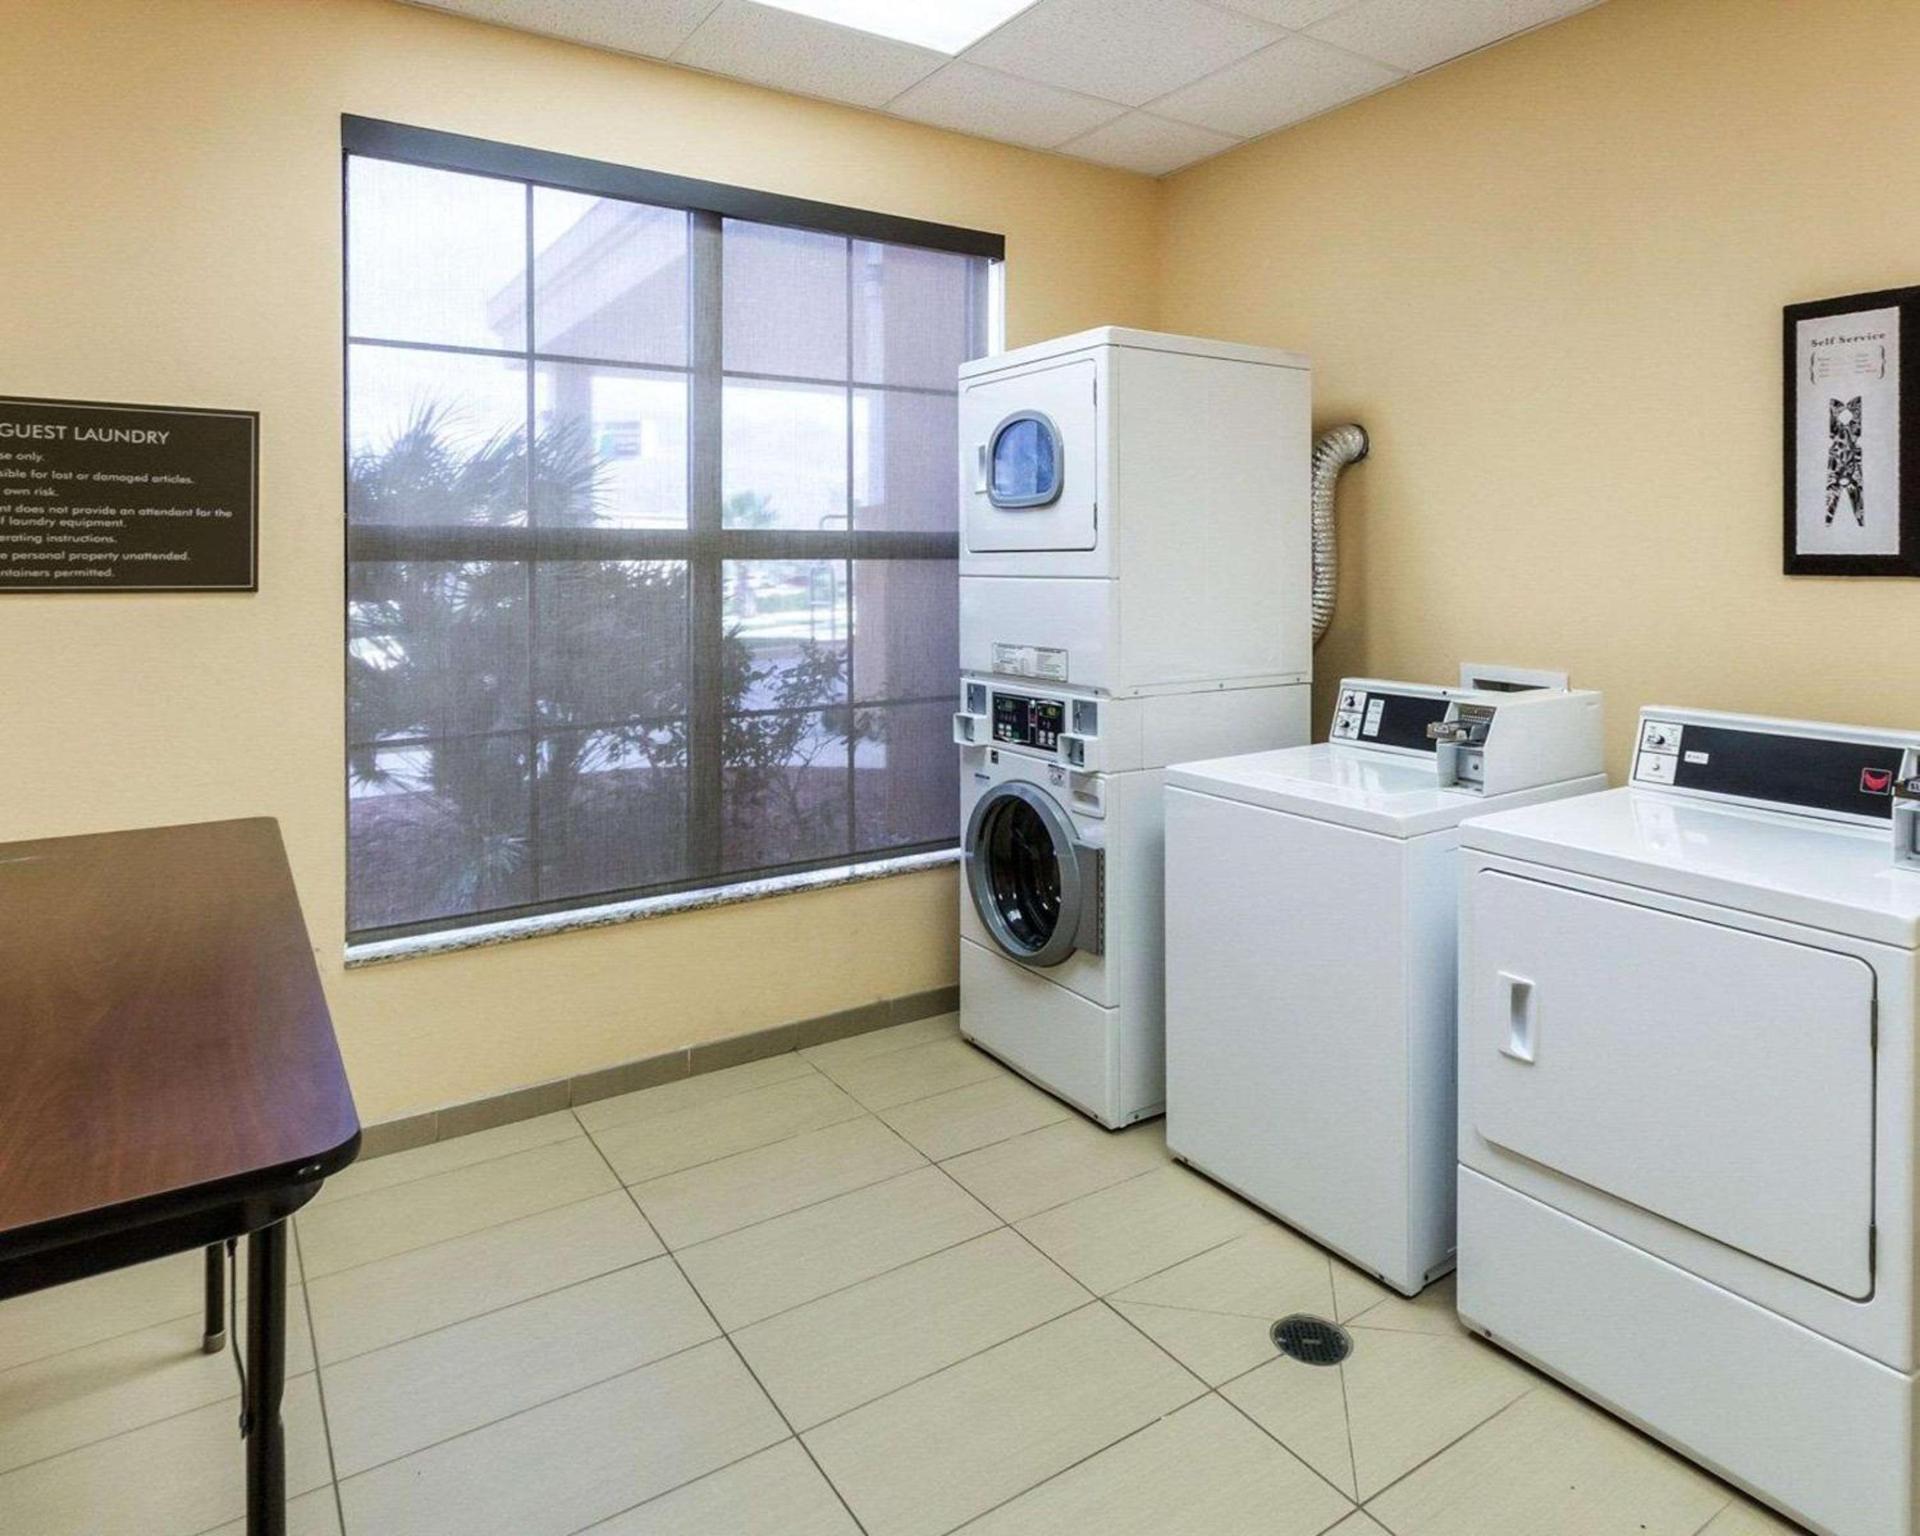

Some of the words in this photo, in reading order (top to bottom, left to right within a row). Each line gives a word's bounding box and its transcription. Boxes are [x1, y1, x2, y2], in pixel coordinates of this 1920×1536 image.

[1811, 336, 1835, 347] Self
[1839, 333, 1885, 343] Service
[0, 423, 67, 439] GUEST
[74, 427, 169, 445] LAUNDRY
[15, 451, 45, 463] only.
[31, 469, 48, 479] for
[51, 470, 73, 480] lost
[76, 473, 89, 481] or
[93, 472, 149, 484] damaged
[3, 487, 31, 496] own
[33, 486, 59, 497] risk.
[15, 504, 45, 514] does
[48, 506, 69, 515] not
[71, 506, 117, 518] provide
[119, 508, 136, 516] an
[138, 507, 193, 516] attendant
[195, 507, 211, 517] for
[214, 508, 232, 517] the
[8, 516, 56, 529] laundry
[58, 518, 128, 529] equipment.
[46, 534, 118, 543] instructions.
[11, 550, 66, 562] personal
[68, 551, 120, 563] property
[121, 551, 191, 562] unattended.
[54, 568, 115, 578] permitted.
